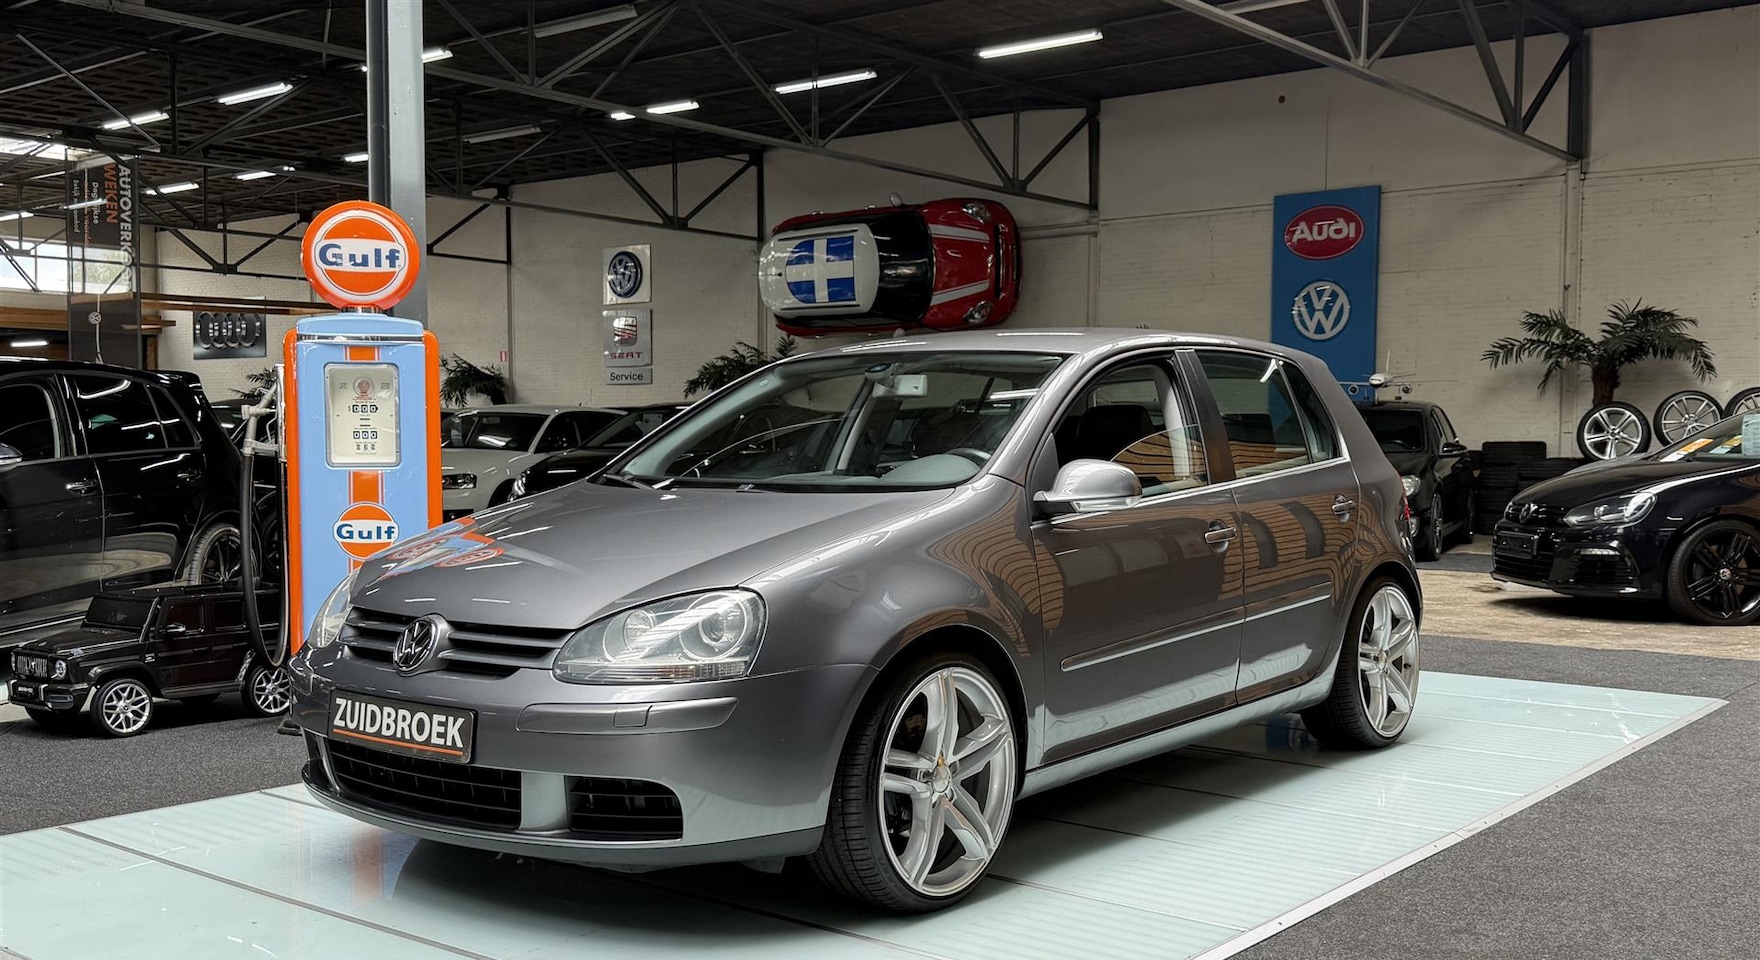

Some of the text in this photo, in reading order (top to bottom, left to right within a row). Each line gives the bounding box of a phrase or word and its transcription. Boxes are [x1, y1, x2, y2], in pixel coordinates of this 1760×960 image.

[103, 163, 119, 224] WEKEN
[319, 243, 401, 268] Gulf
[610, 351, 643, 360] SEAT
[610, 371, 644, 381] Service
[336, 523, 396, 540] Gulf
[333, 697, 465, 748] ZUIDBROEK
